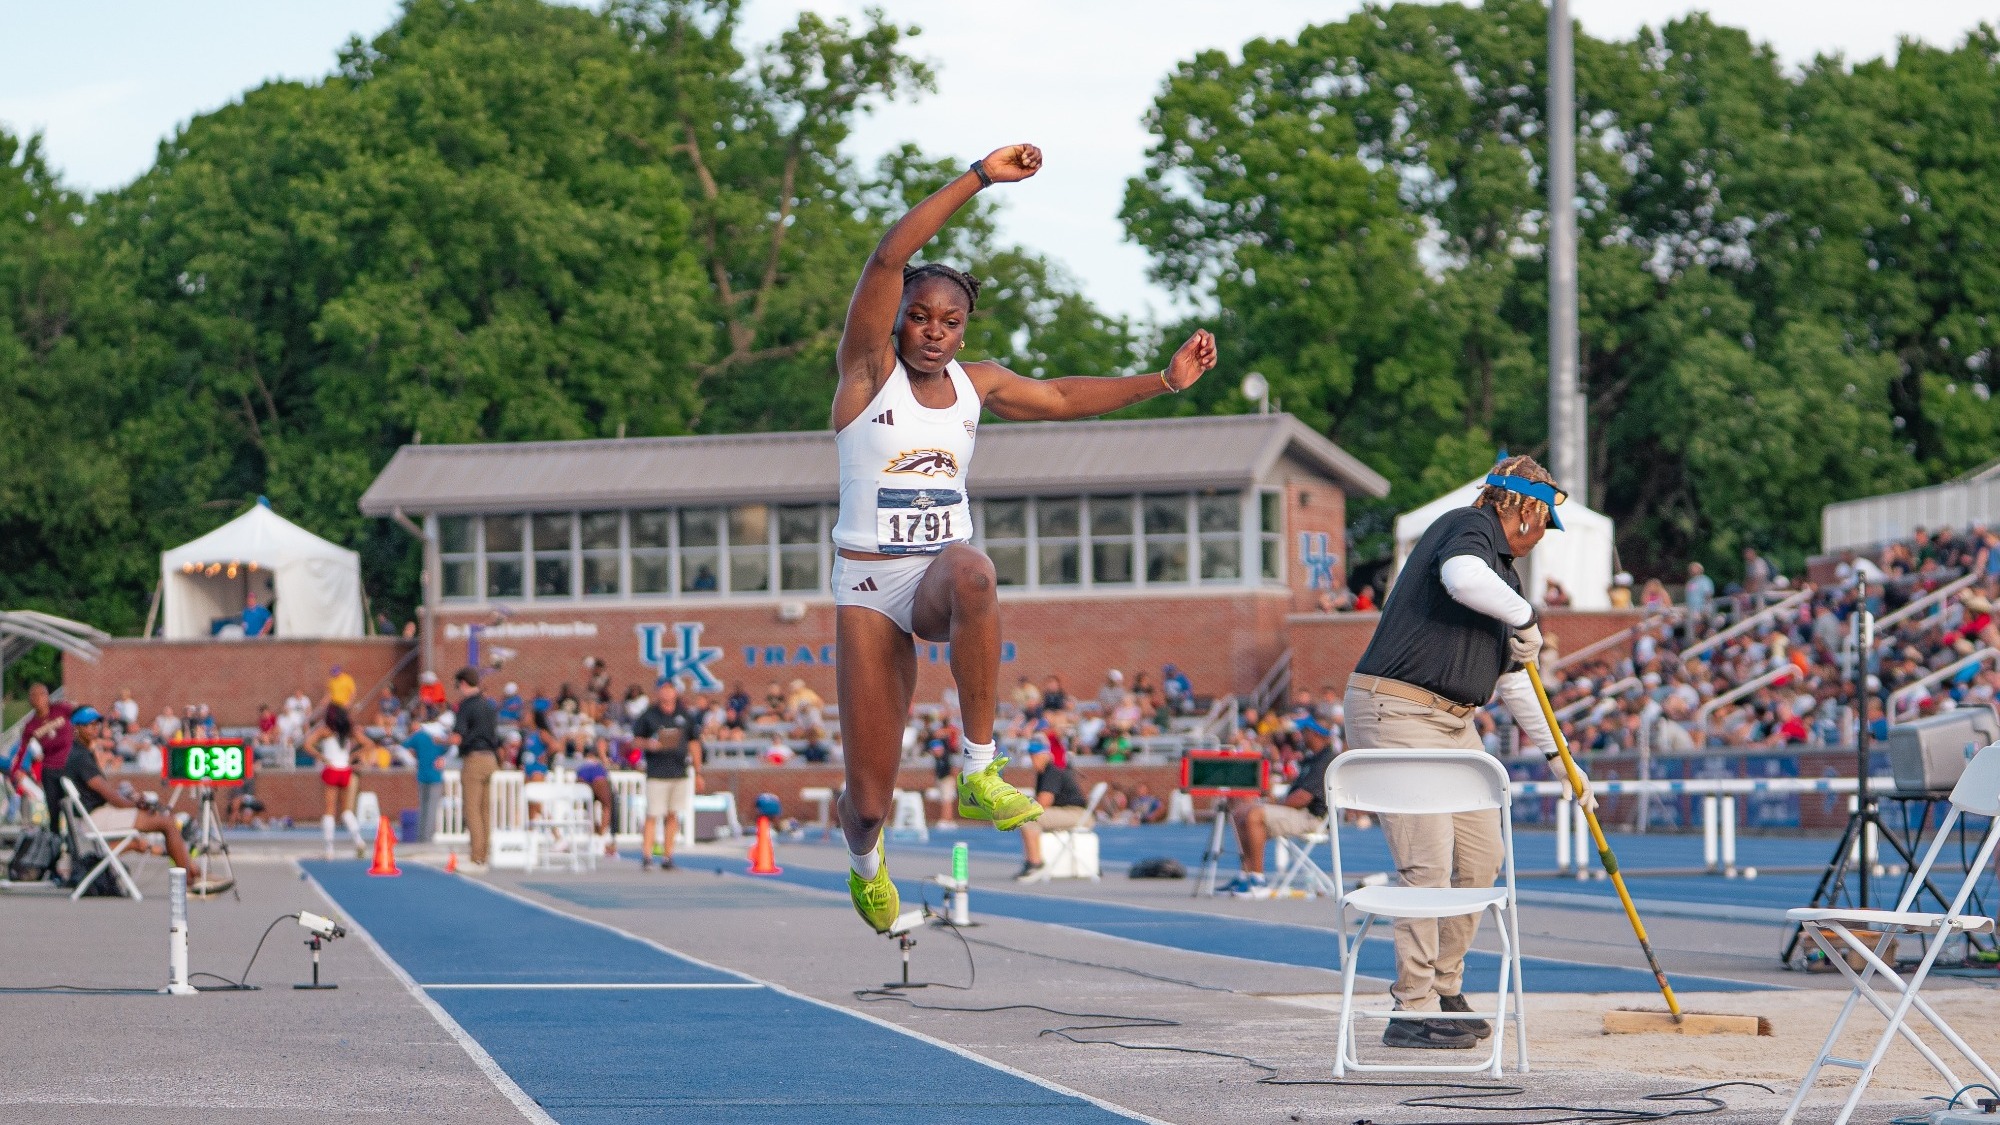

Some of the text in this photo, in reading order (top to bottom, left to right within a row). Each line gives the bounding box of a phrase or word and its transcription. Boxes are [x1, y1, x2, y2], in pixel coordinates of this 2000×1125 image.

[889, 511, 954, 543] 1791
[1299, 532, 1338, 589] UK
[634, 623, 723, 693] UK
[741, 643, 838, 668] TRAC
[186, 746, 244, 780] 0:38
